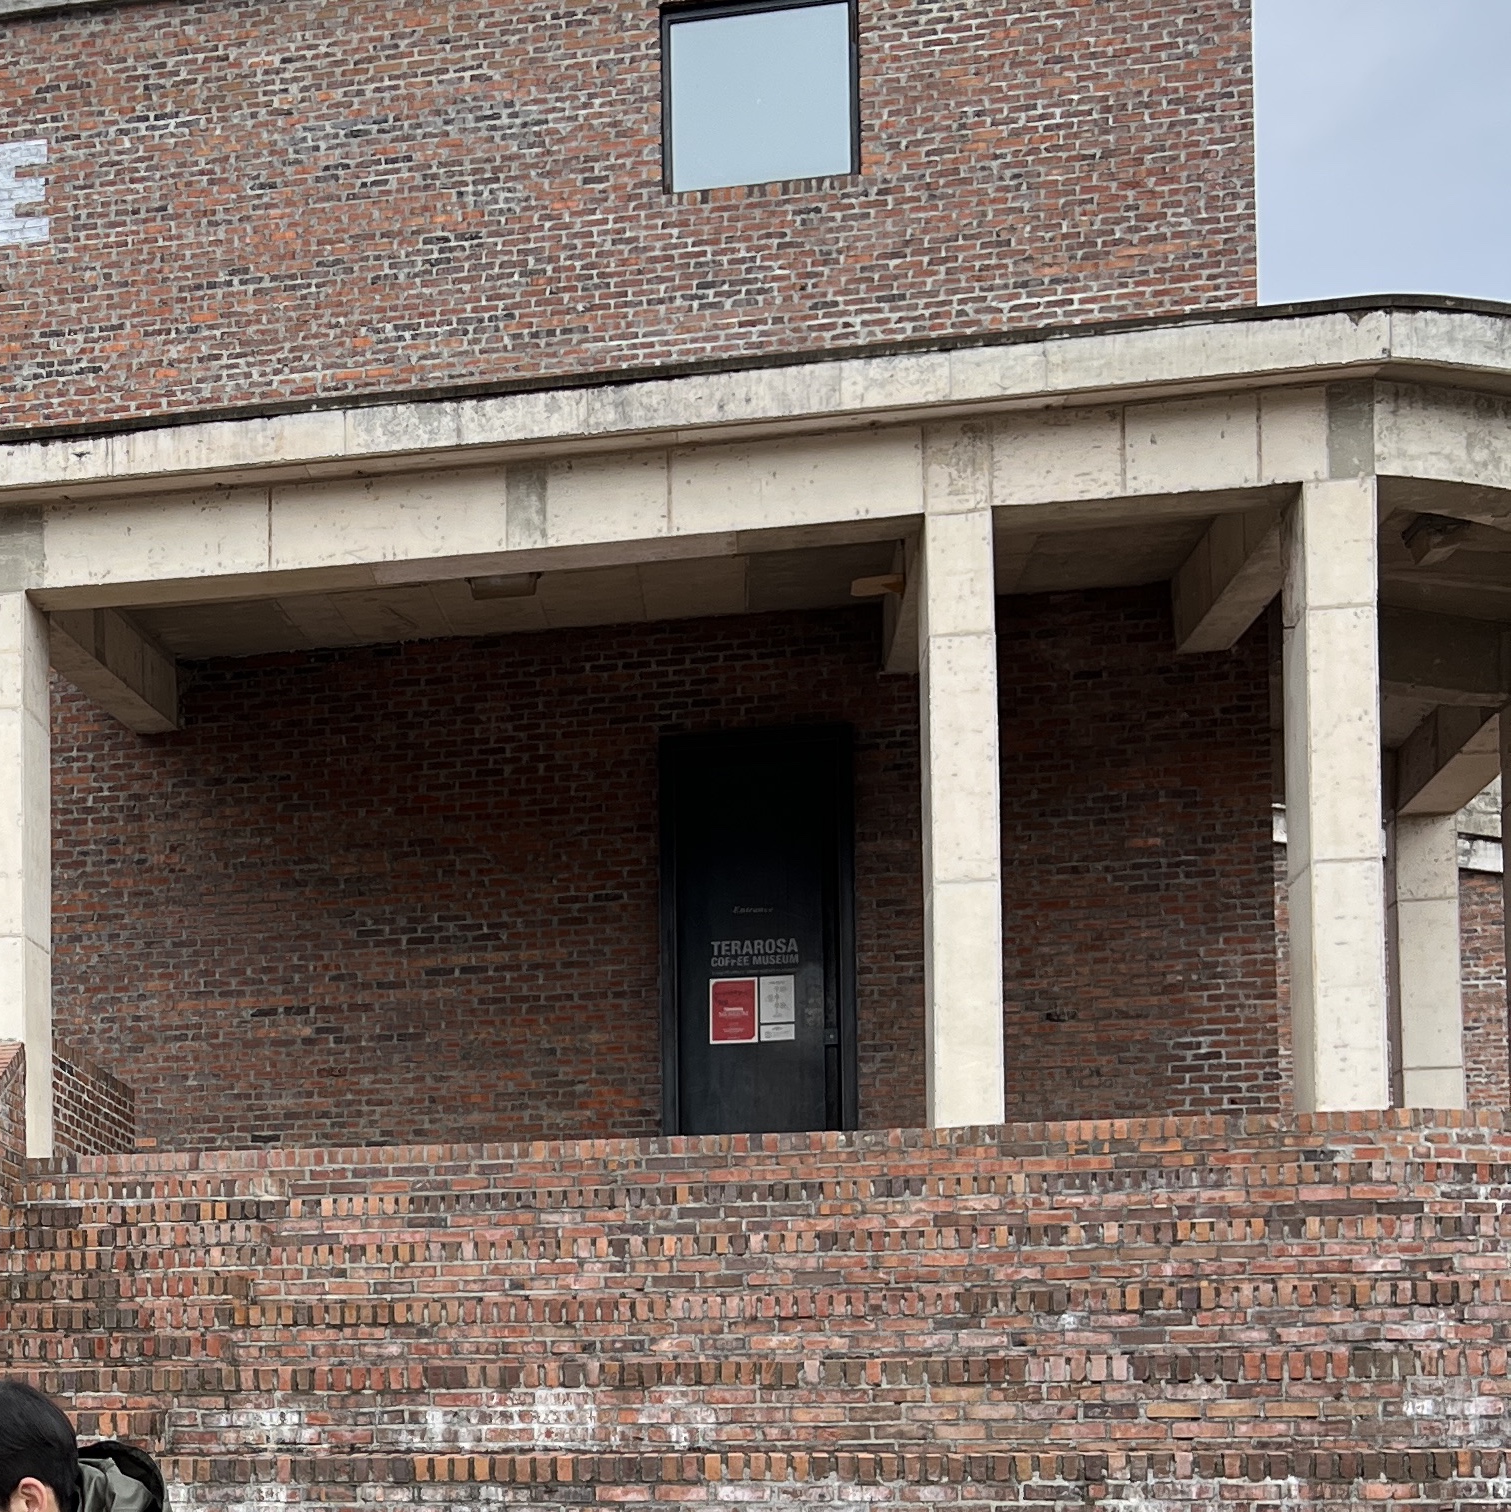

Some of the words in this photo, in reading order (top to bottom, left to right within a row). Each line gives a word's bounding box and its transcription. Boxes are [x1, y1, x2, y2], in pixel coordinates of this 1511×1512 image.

[711, 938, 798, 956] TERAROSA
[710, 956, 750, 967] COFFEE
[752, 954, 799, 966] MUSEUM
